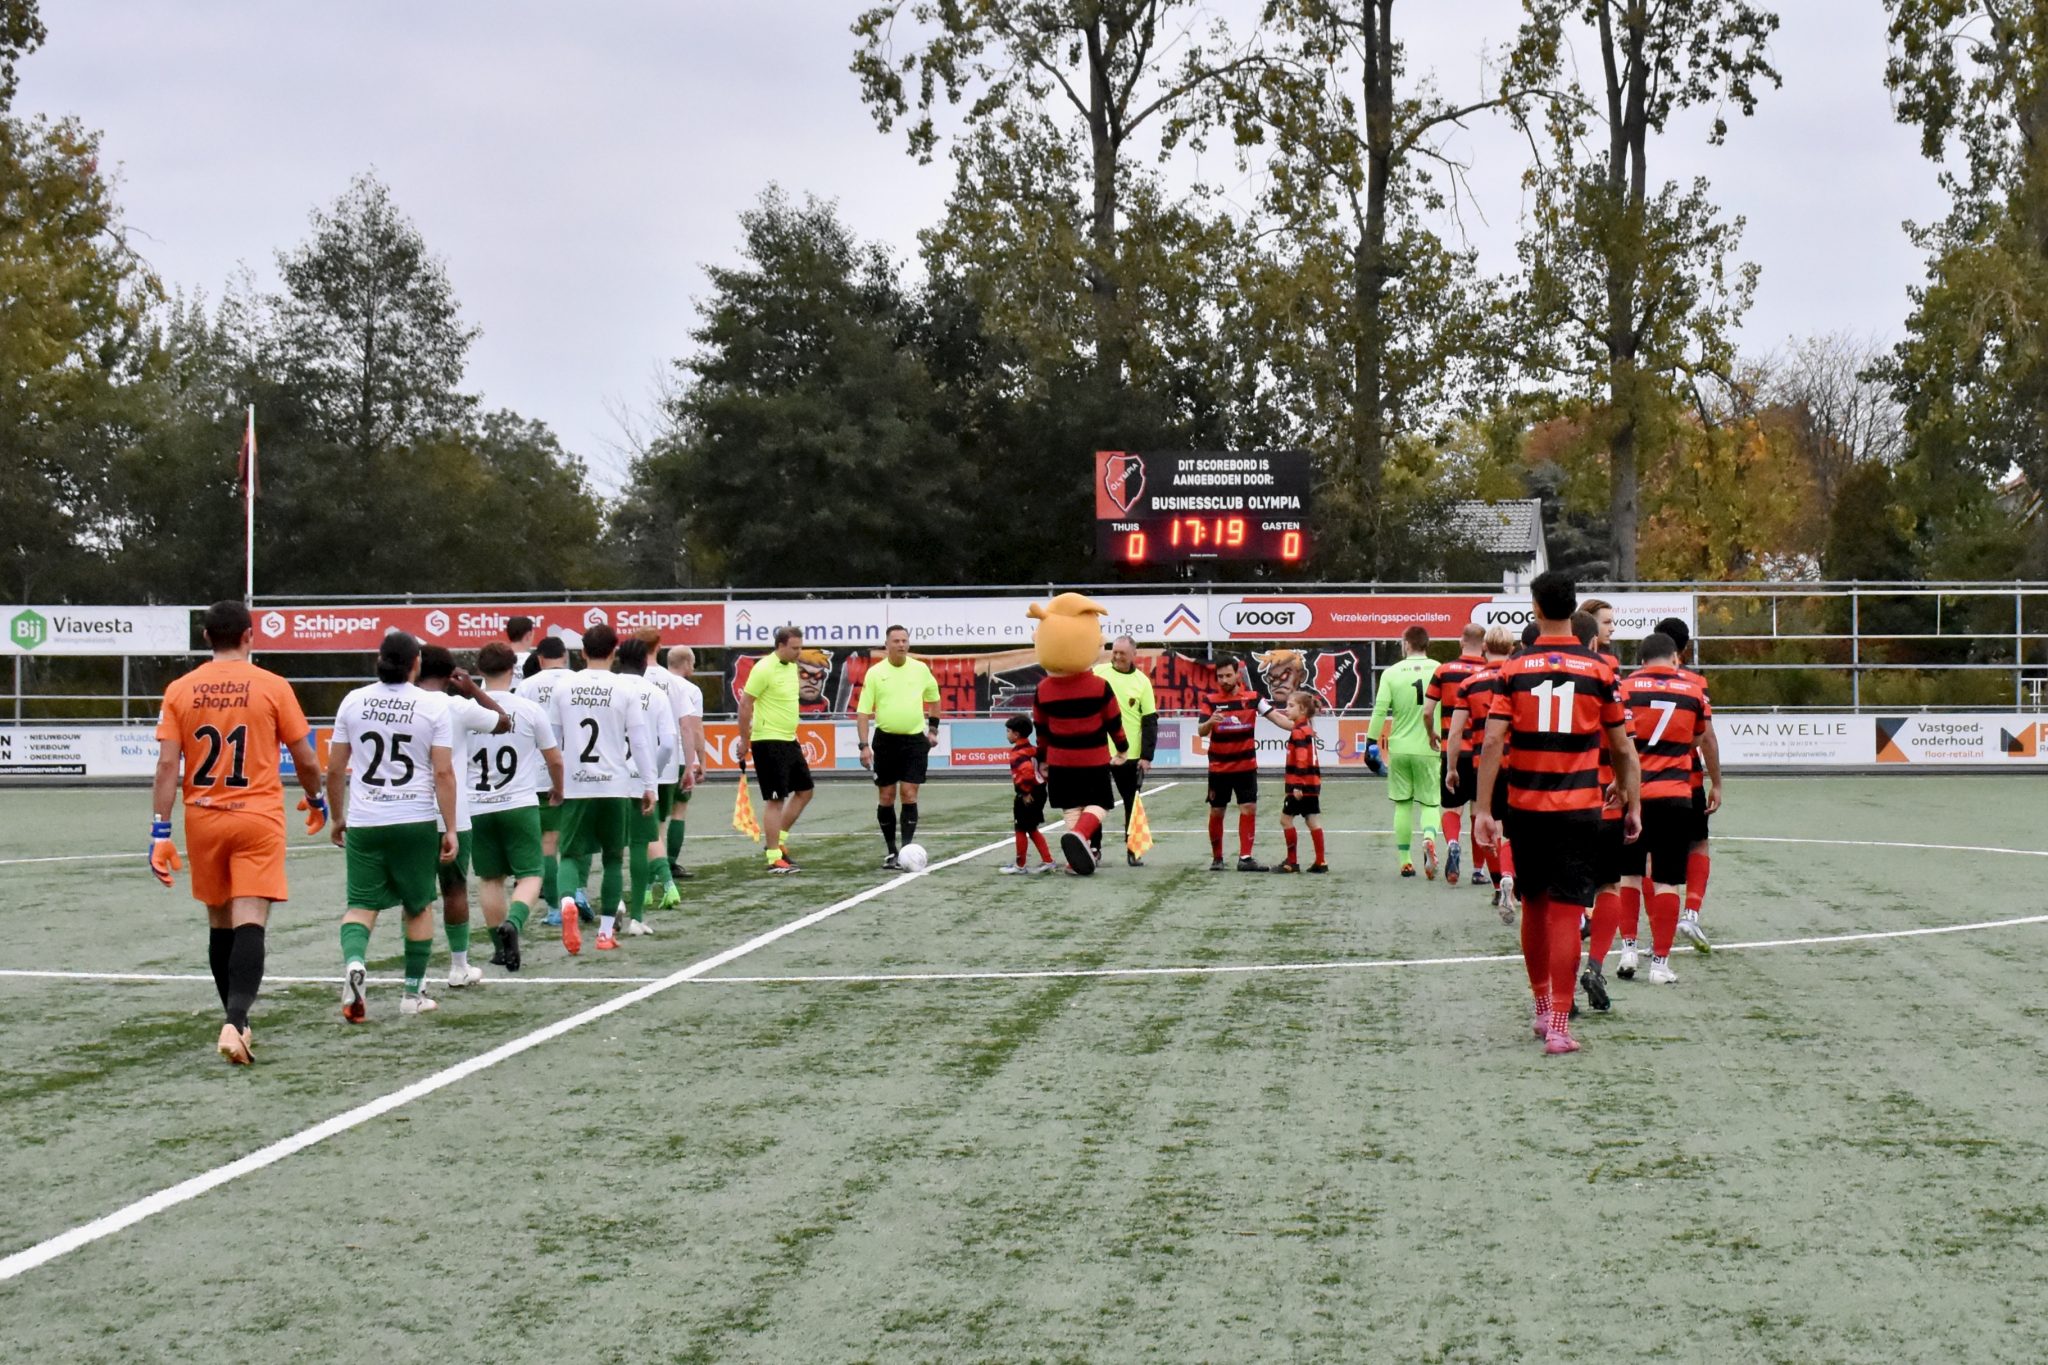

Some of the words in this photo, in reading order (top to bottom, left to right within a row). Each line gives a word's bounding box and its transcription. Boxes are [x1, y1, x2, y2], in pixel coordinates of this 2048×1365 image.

[1178, 459, 1195, 471] DIT
[1196, 459, 1257, 471] SCOREBORD
[1258, 459, 1269, 470] IS
[1110, 462, 1139, 492] OLYMPIA
[1173, 474, 1242, 485] AANGEBODEN
[1243, 474, 1274, 485] DOOR:
[1152, 497, 1244, 510] BUSINESSCLUB
[1248, 496, 1301, 509] OLYMPIA
[1112, 523, 1140, 531] THUIS
[1170, 518, 1245, 546] 17:19
[1262, 522, 1300, 530] GASTEN
[1127, 532, 1145, 560] 0
[1283, 532, 1300, 560] 0
[1644, 606, 1688, 614] verzekerd!
[53, 617, 133, 633] Viavesta
[294, 614, 380, 634] Schipper
[458, 612, 544, 632] Schiper
[616, 610, 702, 630] Schipper
[1236, 611, 1295, 625] VOOGT
[1330, 612, 1451, 624] Verzekeringsspecialisten
[1487, 611, 1536, 625] VOOG
[17, 620, 41, 642] Bij
[293, 631, 333, 639] kozijnen
[907, 622, 997, 639] ypotheken
[1004, 626, 1023, 635] en
[1524, 658, 1545, 668] IRIS
[1321, 658, 1352, 695] OLYMPIA
[192, 681, 250, 694] voetbal
[571, 685, 614, 697] voetbal
[1634, 680, 1653, 688] IRIS
[1412, 679, 1424, 705] 1
[193, 694, 249, 711] shop.nl
[363, 697, 416, 711] voetbal
[571, 696, 612, 708] shop.nl
[1530, 680, 1576, 734] 11
[361, 708, 414, 725] shop.nl
[1650, 699, 1677, 746] 7
[1730, 723, 1769, 736] VAN
[1776, 723, 1847, 736] WELIE
[1918, 722, 1984, 735] Vastgoed-
[579, 717, 600, 763] 2
[1911, 735, 1984, 746] onderhoud
[121, 745, 142, 755] Rob
[147, 748, 159, 756] va
[193, 724, 249, 788] 21
[1925, 750, 1984, 758] floor-retail.nl
[360, 731, 415, 787] 25
[955, 752, 967, 761] De
[968, 752, 986, 761] GSG
[987, 752, 1010, 763] geeft
[472, 745, 518, 792] 19
